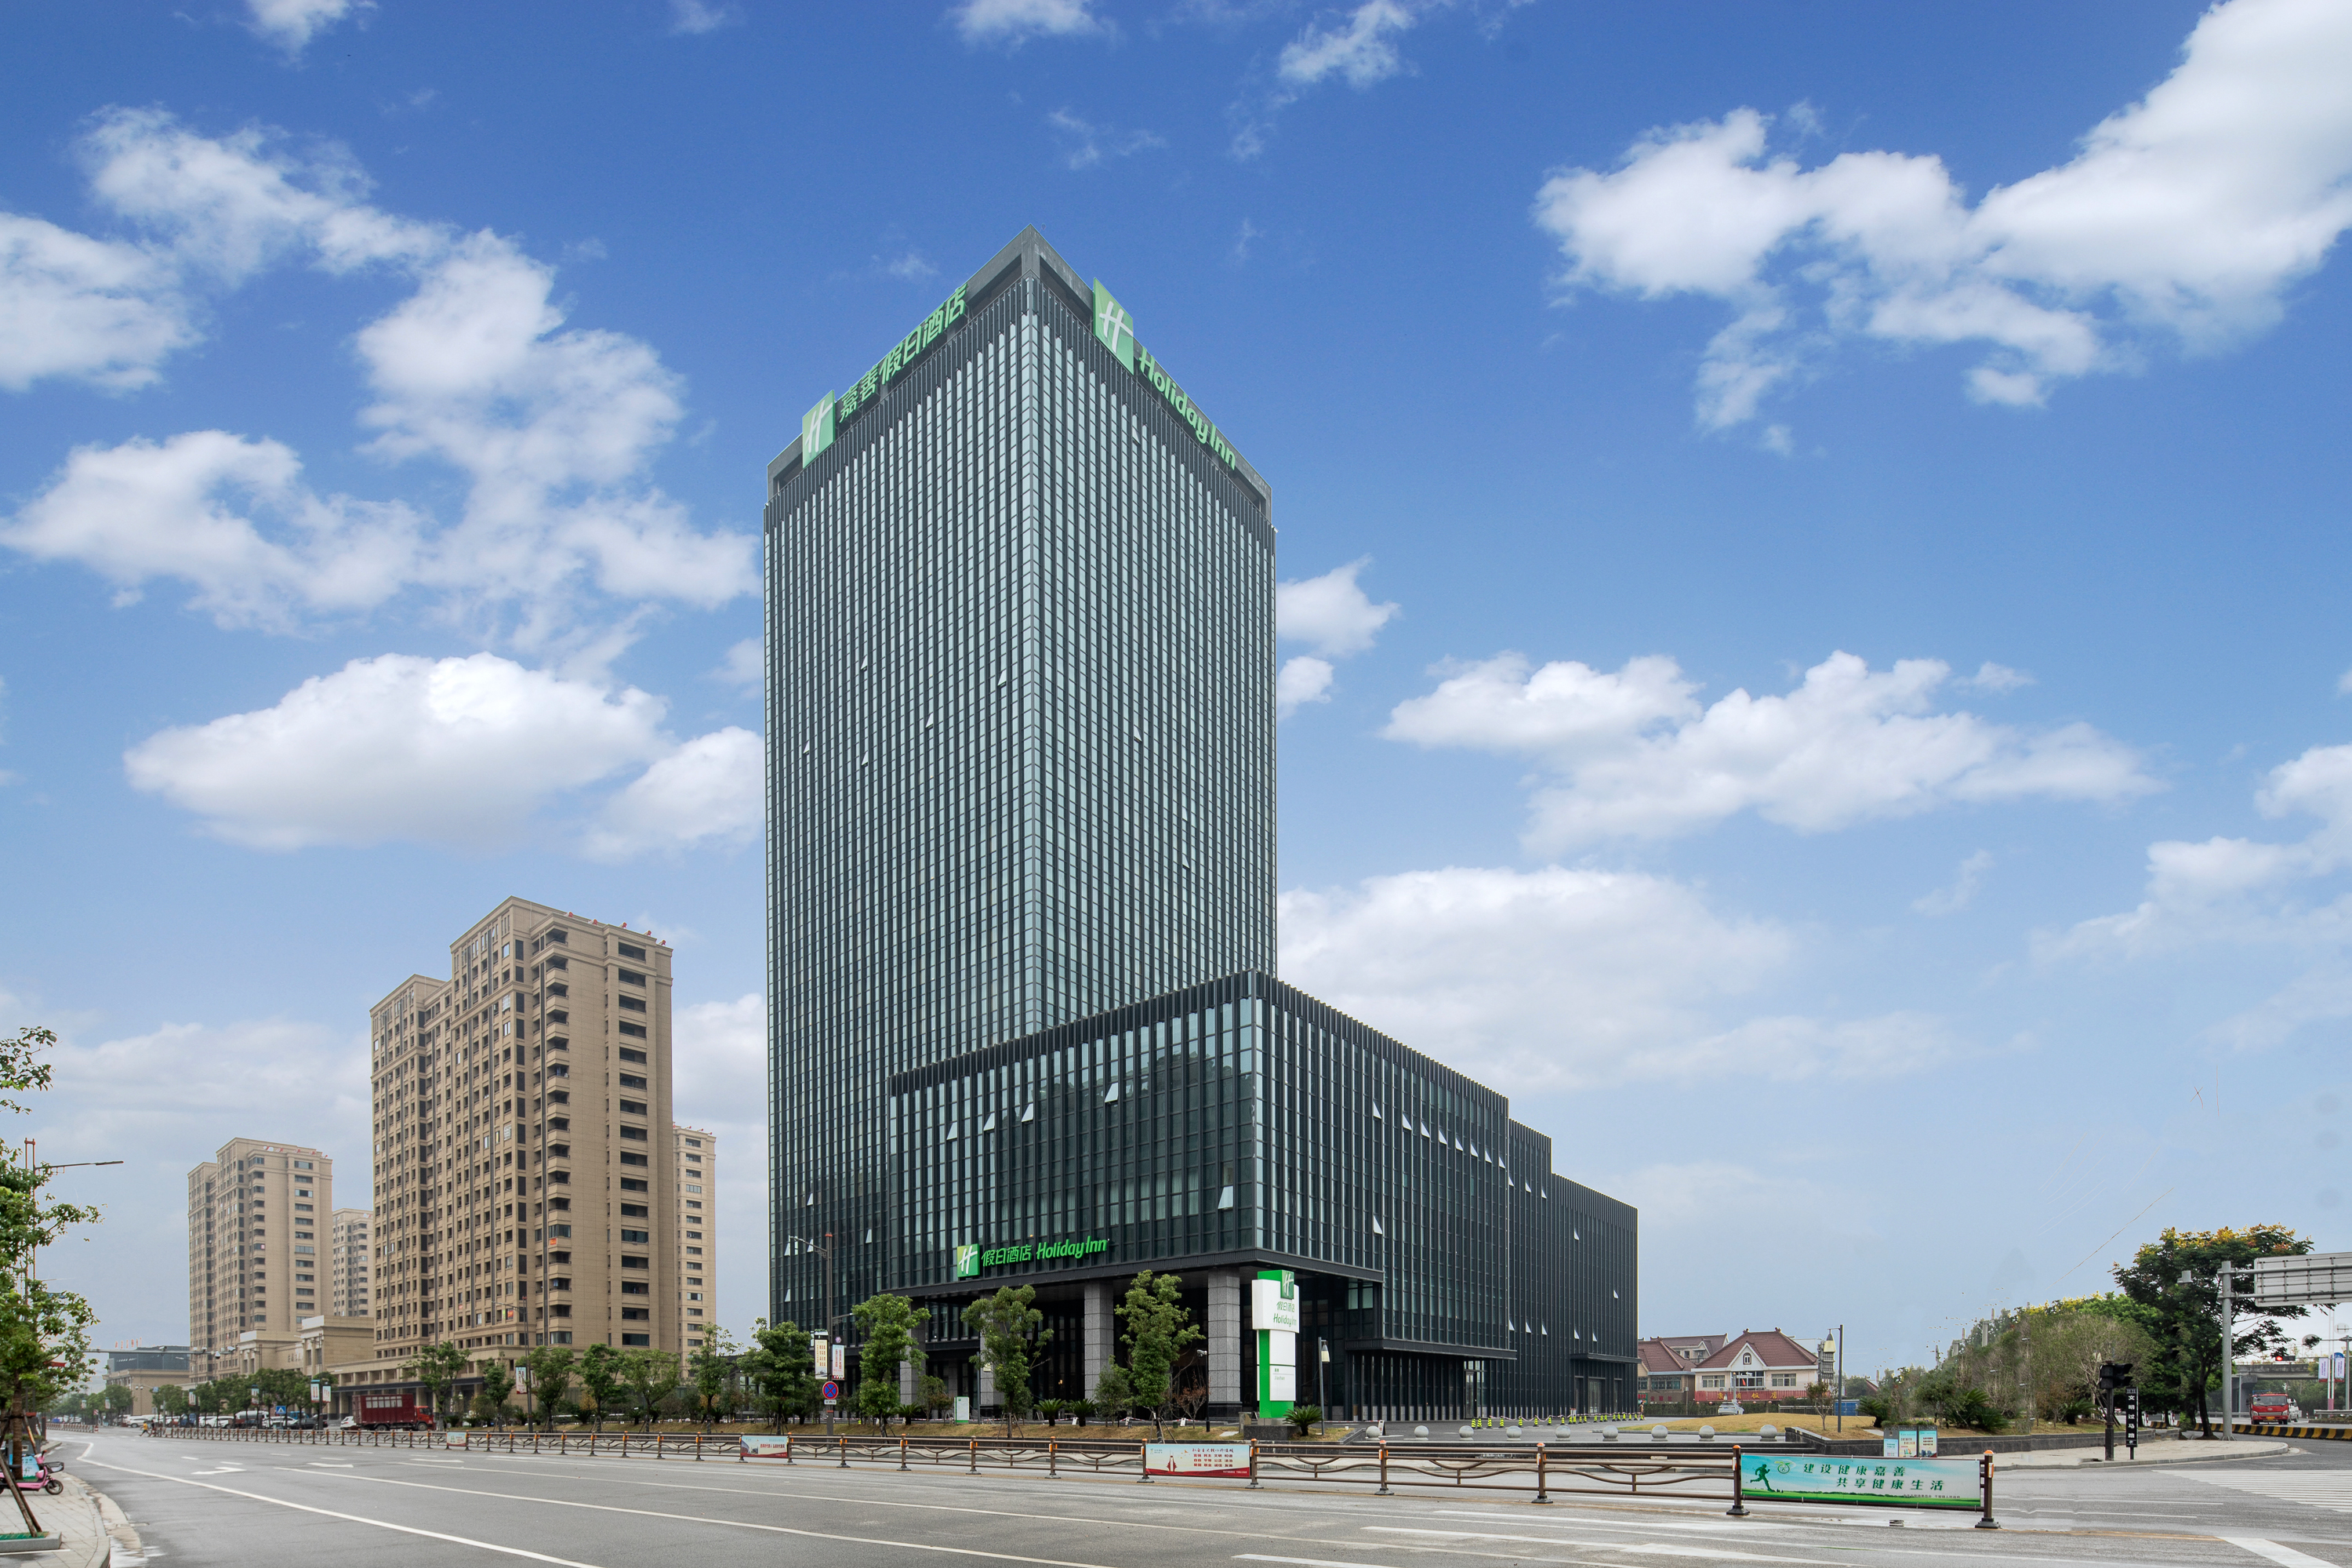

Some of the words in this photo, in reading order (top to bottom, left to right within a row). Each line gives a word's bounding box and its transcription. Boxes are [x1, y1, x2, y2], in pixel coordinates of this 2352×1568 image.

[839, 283, 967, 424] 嘉善假日酒店
[1138, 347, 1209, 445] Holiday
[1210, 423, 1236, 471] Inn
[981, 1243, 1033, 1267] 假日酒店
[1036, 1239, 1086, 1260] Holiday
[1085, 1235, 1108, 1254] Inn
[1276, 1301, 1295, 1312] 假日酒店
[1272, 1313, 1292, 1327] Holiday
[1803, 1463, 1906, 1477] 建设健康嘉善
[1836, 1477, 1944, 1491] 共享健康生活
